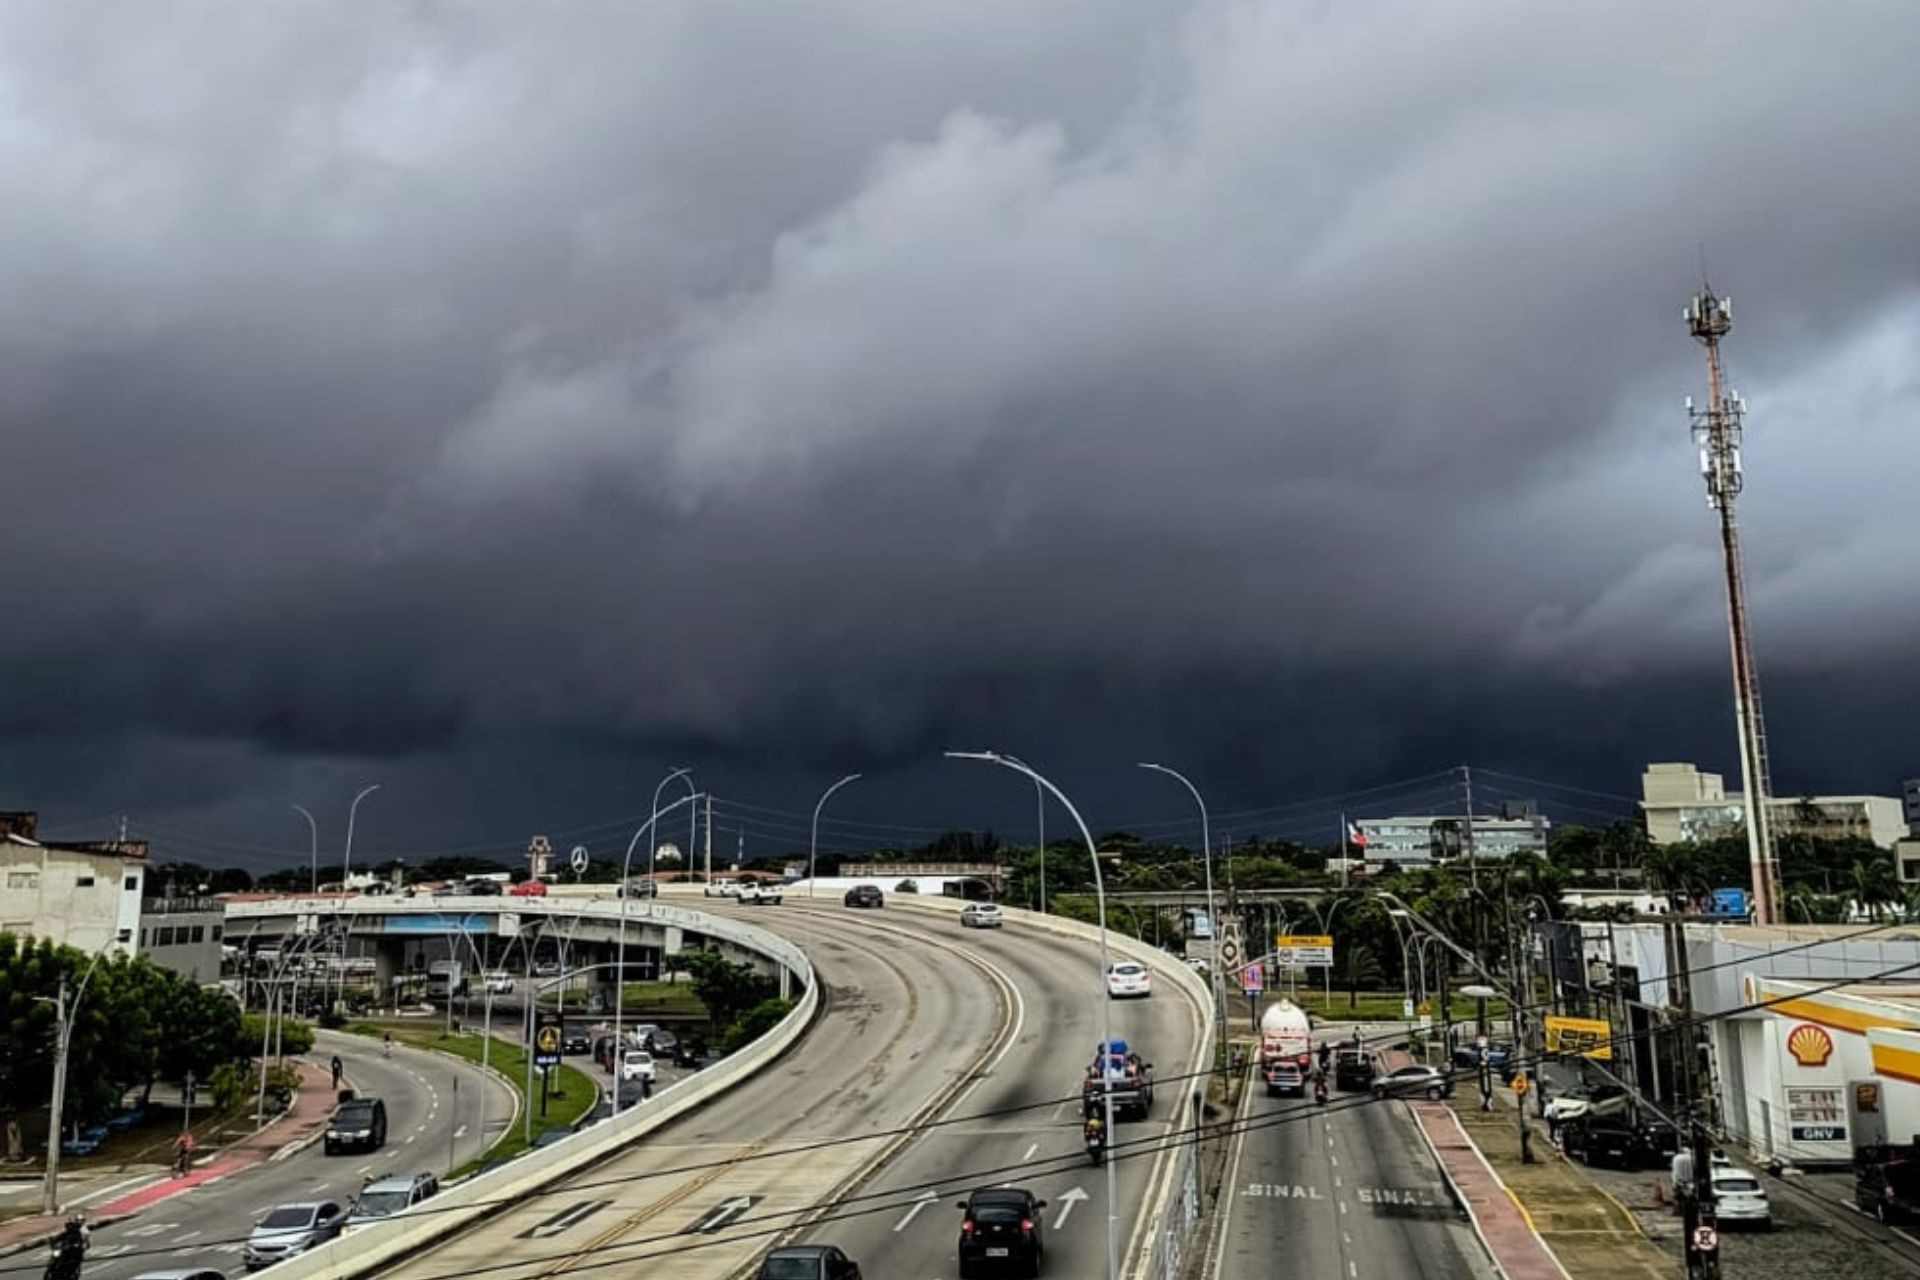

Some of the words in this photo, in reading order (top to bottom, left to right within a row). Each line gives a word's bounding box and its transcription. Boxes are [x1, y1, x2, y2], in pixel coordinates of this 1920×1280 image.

[1803, 1127, 1834, 1140] GNV
[1245, 1183, 1324, 1199] SINAL
[1357, 1188, 1432, 1206] SINAL
